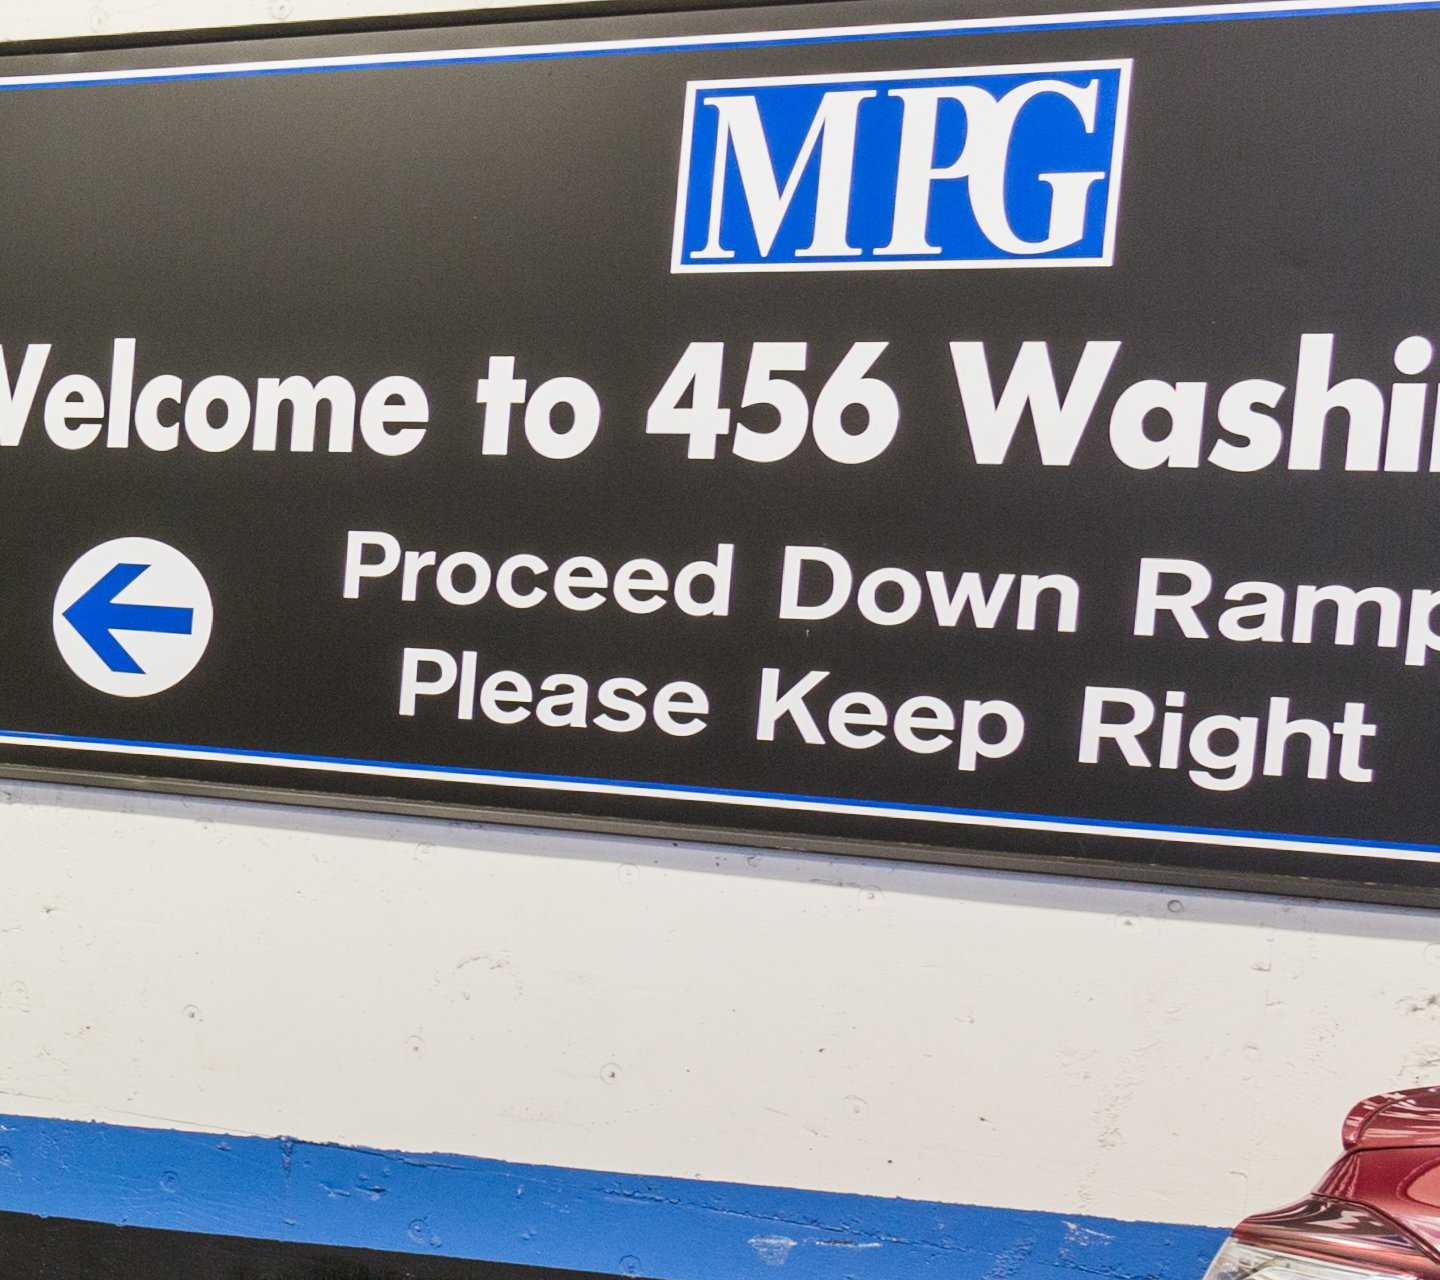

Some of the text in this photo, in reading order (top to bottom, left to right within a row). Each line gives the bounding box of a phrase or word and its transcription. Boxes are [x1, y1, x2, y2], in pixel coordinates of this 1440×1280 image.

[690, 79, 1106, 259] MPG
[477, 355, 601, 460] to
[645, 340, 900, 464] 456
[949, 333, 1440, 473] Washi
[342, 530, 735, 619] Proceed
[778, 544, 1080, 634] Down
[399, 648, 1378, 792] Please Keep Right
